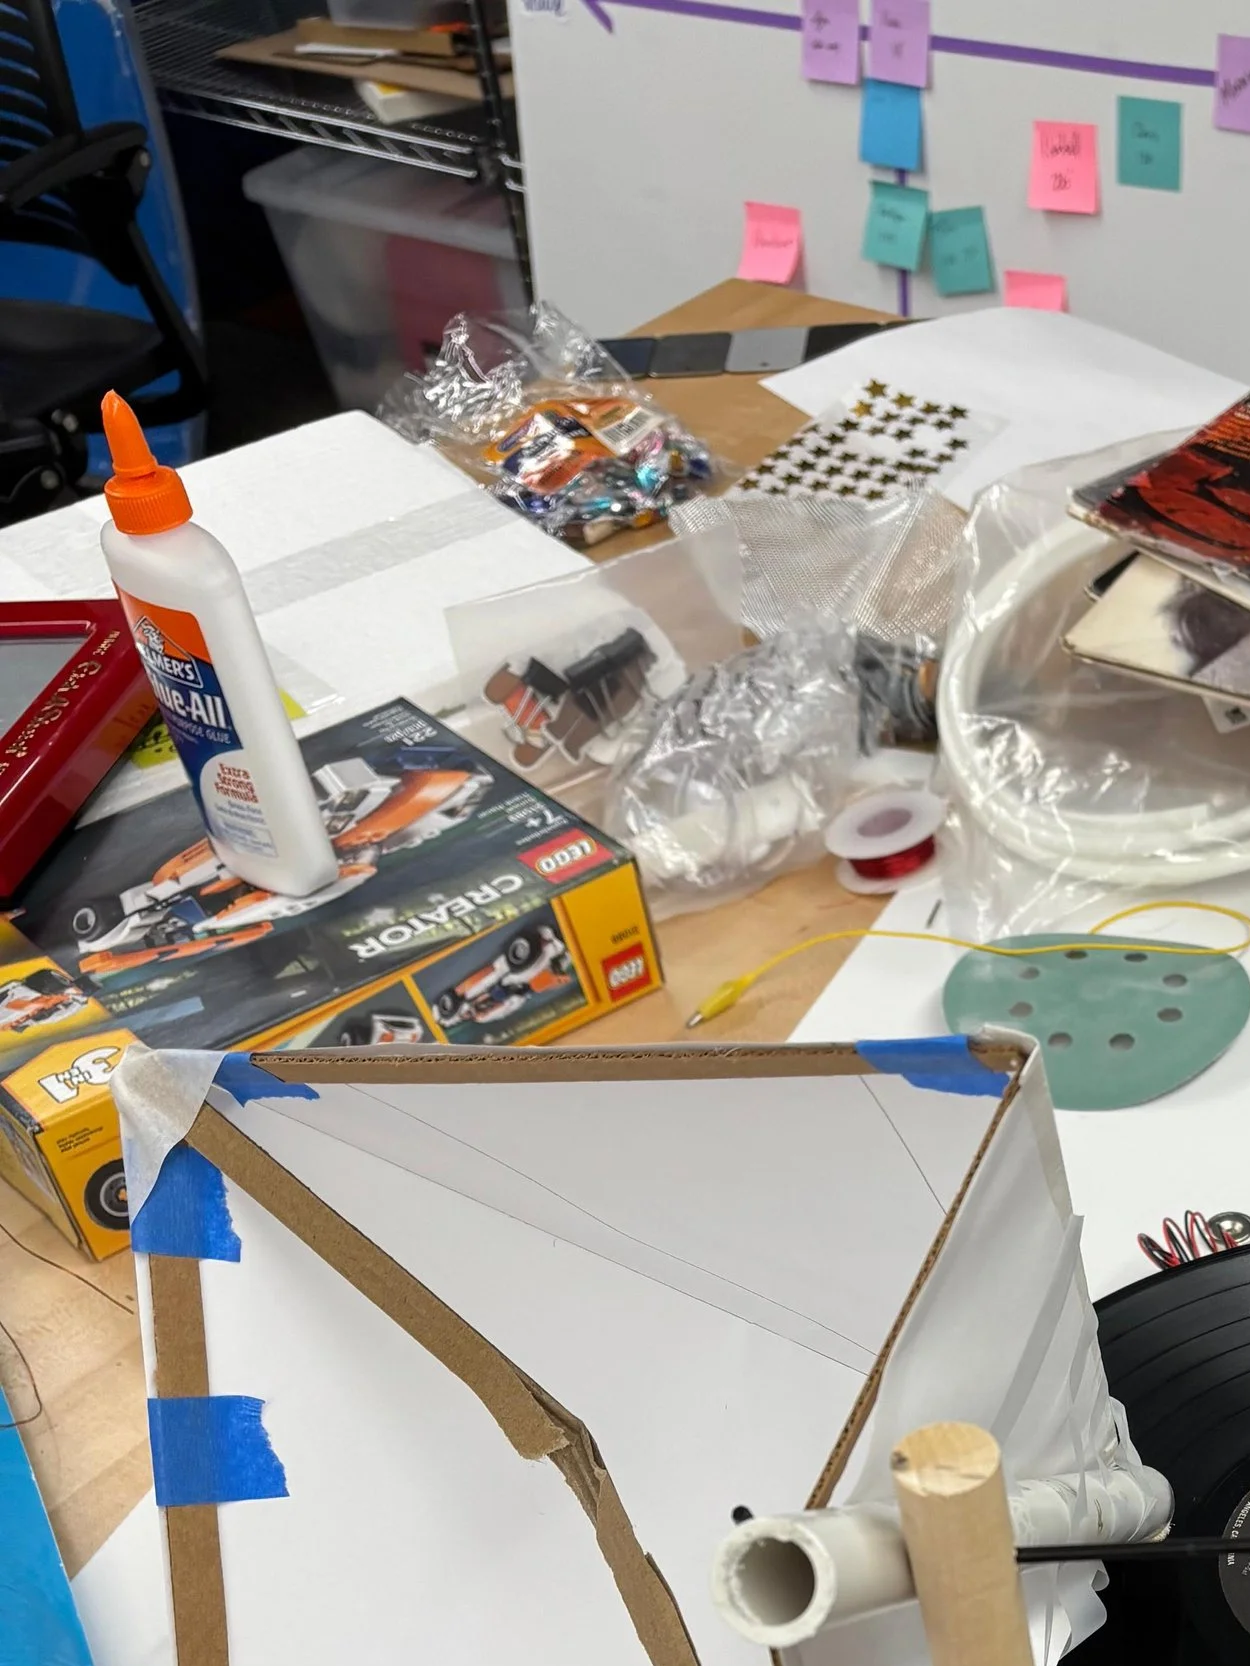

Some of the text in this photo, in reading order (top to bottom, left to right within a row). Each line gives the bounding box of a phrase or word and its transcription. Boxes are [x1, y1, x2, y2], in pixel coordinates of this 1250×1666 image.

[219, 763, 249, 779] Extra
[525, 810, 555, 828] 7+
[540, 839, 592, 872] LEGO
[346, 869, 524, 964] CREATOR
[606, 954, 646, 990] LEGO
